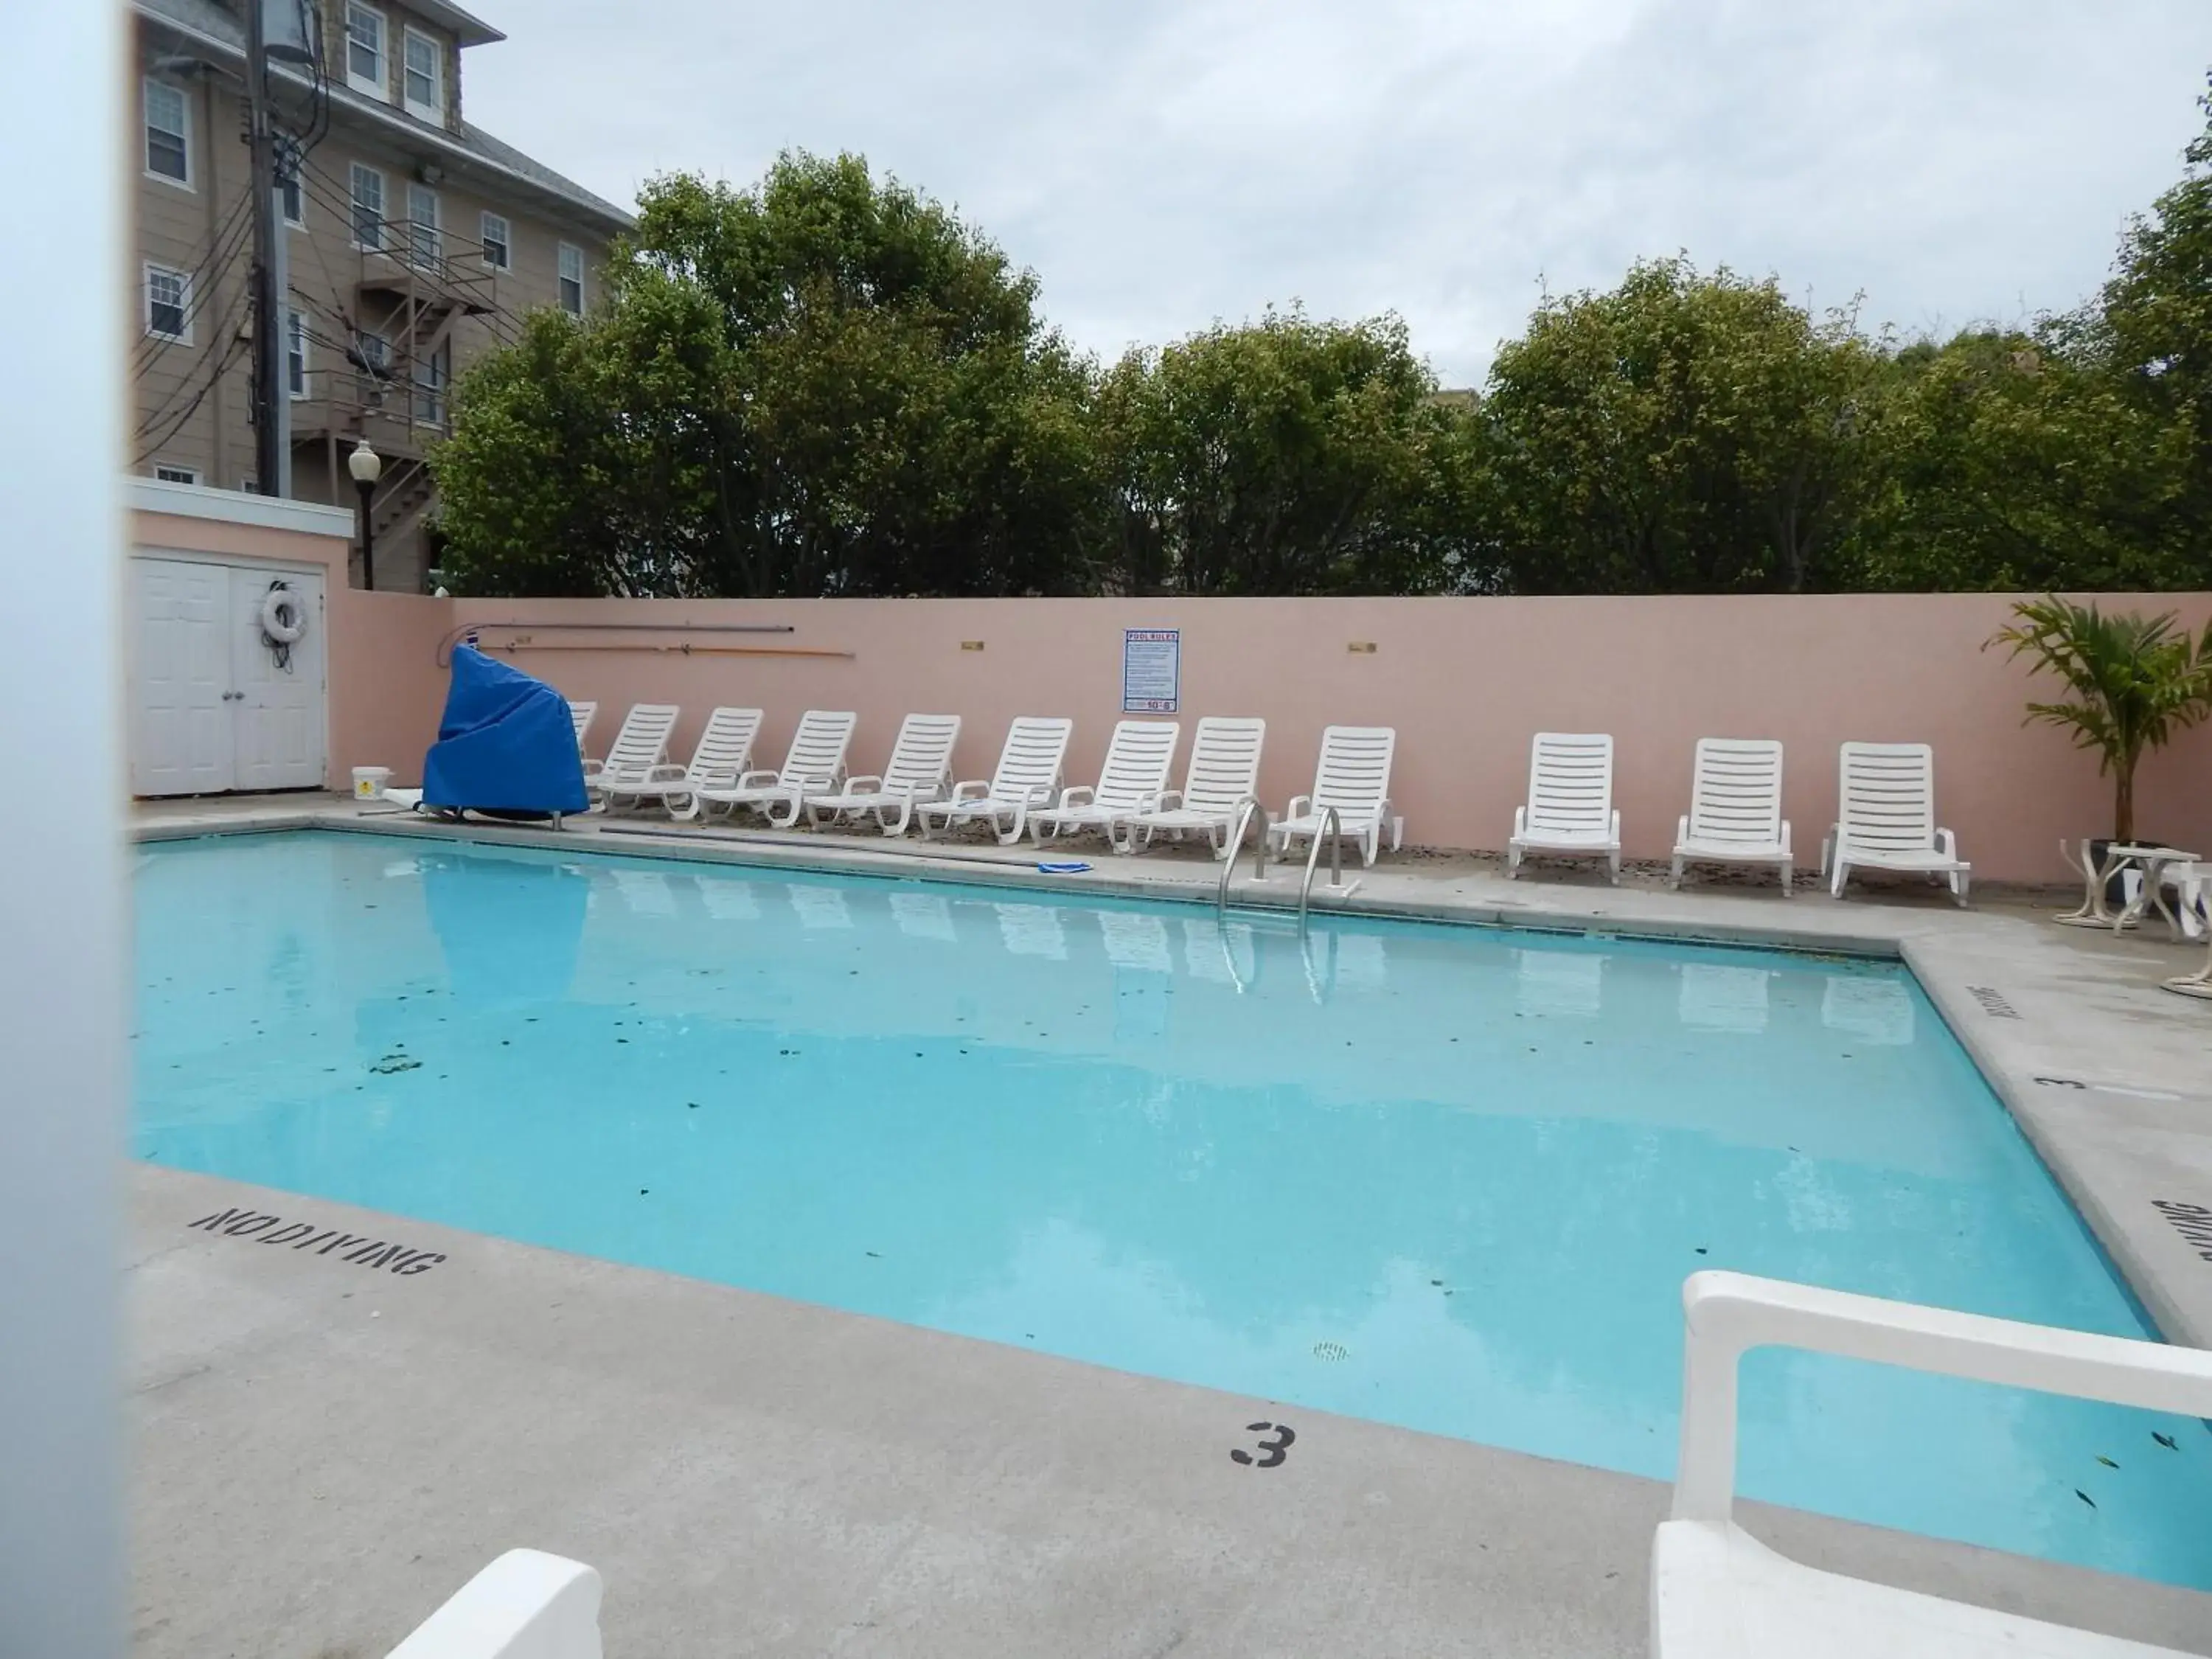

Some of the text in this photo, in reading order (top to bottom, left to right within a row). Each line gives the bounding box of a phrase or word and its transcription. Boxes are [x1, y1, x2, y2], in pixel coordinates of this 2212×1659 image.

[187, 1207, 448, 1276] NO DIVING
[1231, 1422, 1296, 1468] 3
